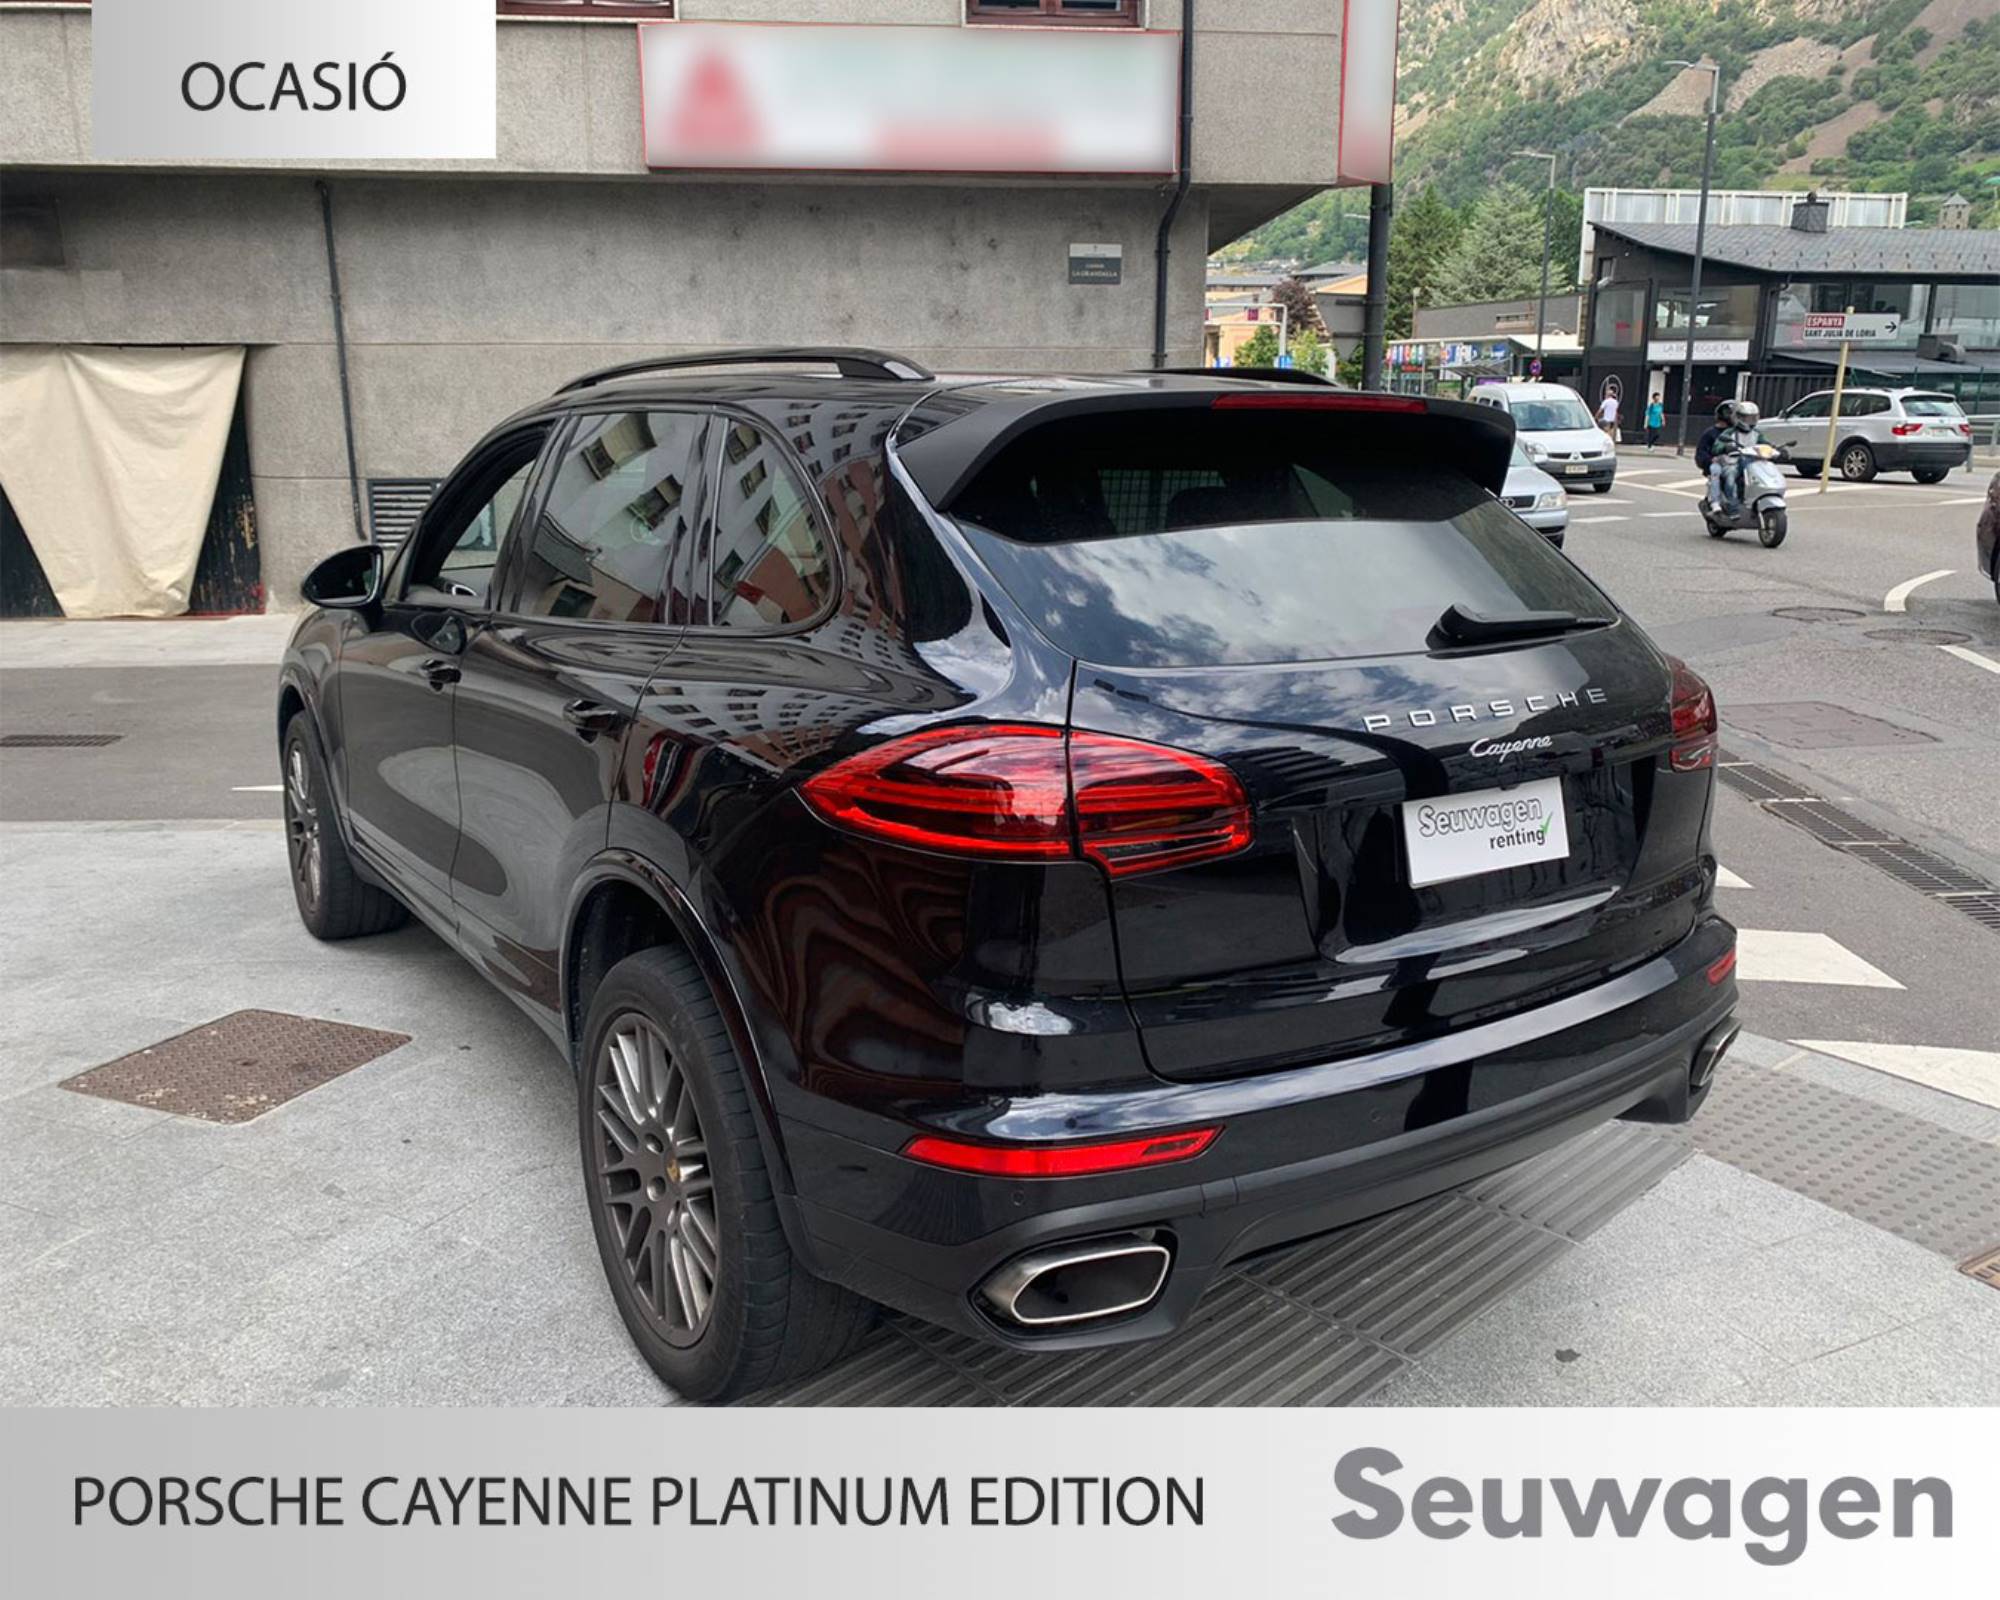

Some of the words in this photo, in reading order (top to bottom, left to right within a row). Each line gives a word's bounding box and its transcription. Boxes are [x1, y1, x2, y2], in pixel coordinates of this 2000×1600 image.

[1805, 329, 1821, 337] SANT
[1845, 329, 1854, 337] DE
[1807, 315, 1843, 327] ESPANYA
[1363, 688, 1608, 733] PORSCHE
[1469, 734, 1553, 763] Cayenne
[1417, 798, 1544, 838] Seuwagen
[1489, 828, 1546, 850] renting
